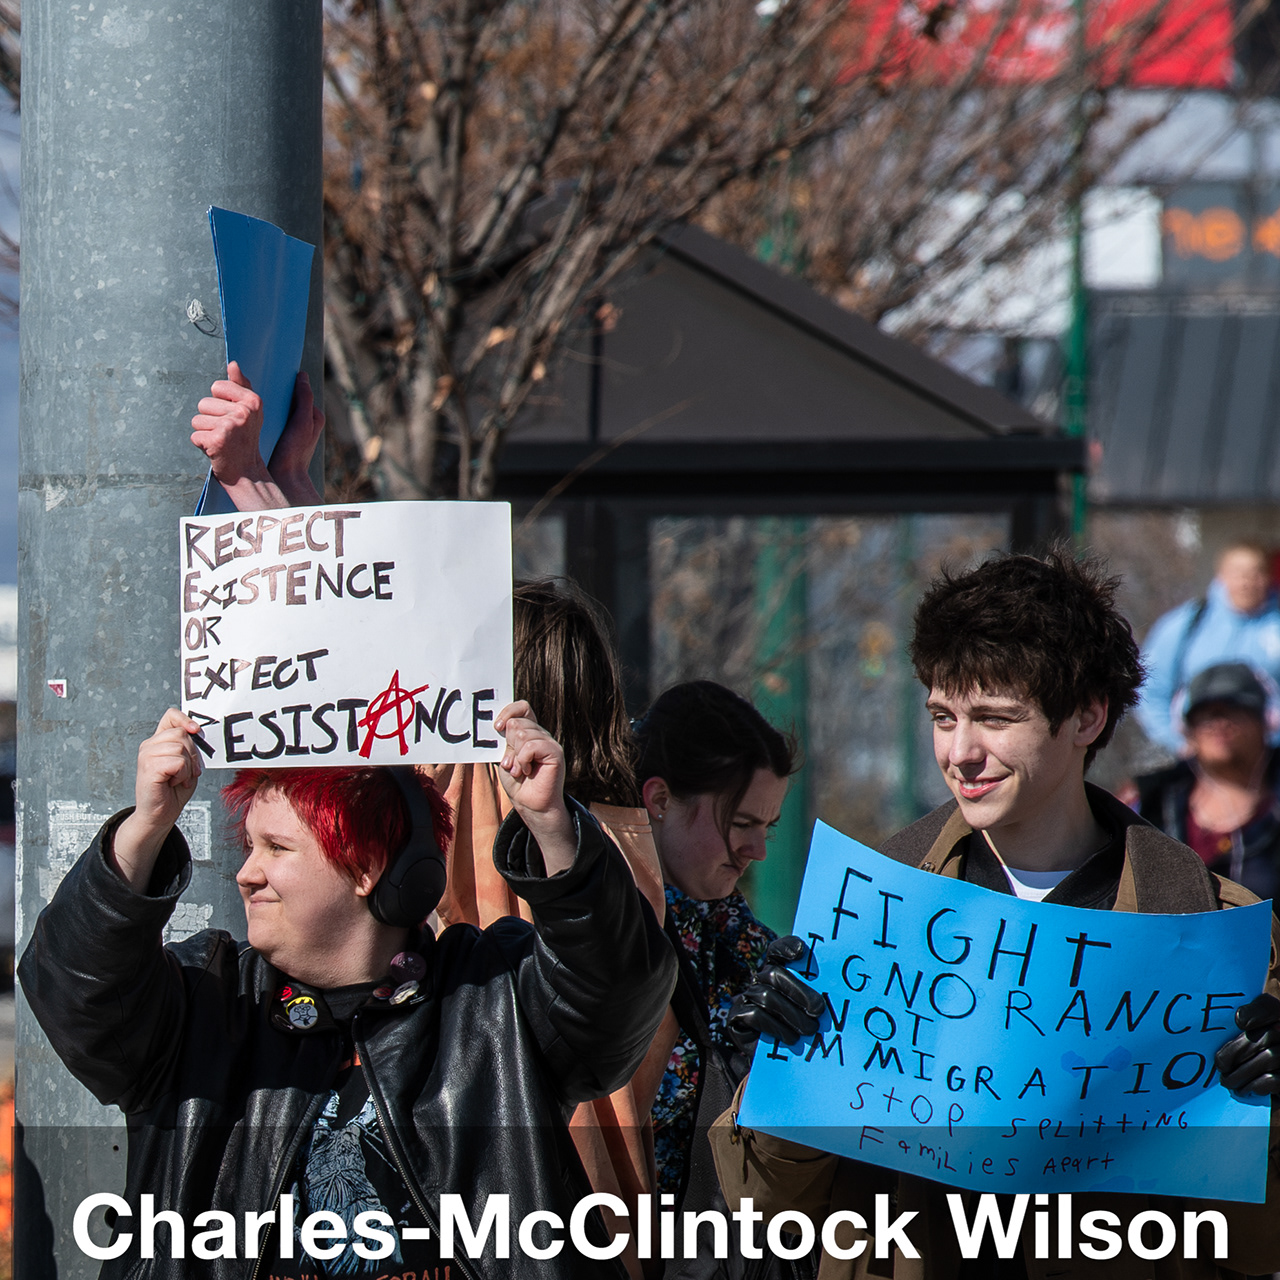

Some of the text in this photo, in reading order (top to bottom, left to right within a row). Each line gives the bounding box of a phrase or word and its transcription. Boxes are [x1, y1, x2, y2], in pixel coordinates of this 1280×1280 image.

[185, 511, 361, 571] RESPECT
[184, 562, 395, 613] EXISTENCE
[185, 617, 222, 650] OR
[185, 649, 329, 701] EXPECT
[188, 669, 498, 762] RESISTANCE
[831, 866, 1112, 988] FIGHT
[798, 932, 1245, 1038] IGNORANCE
[822, 992, 934, 1047] NOT
